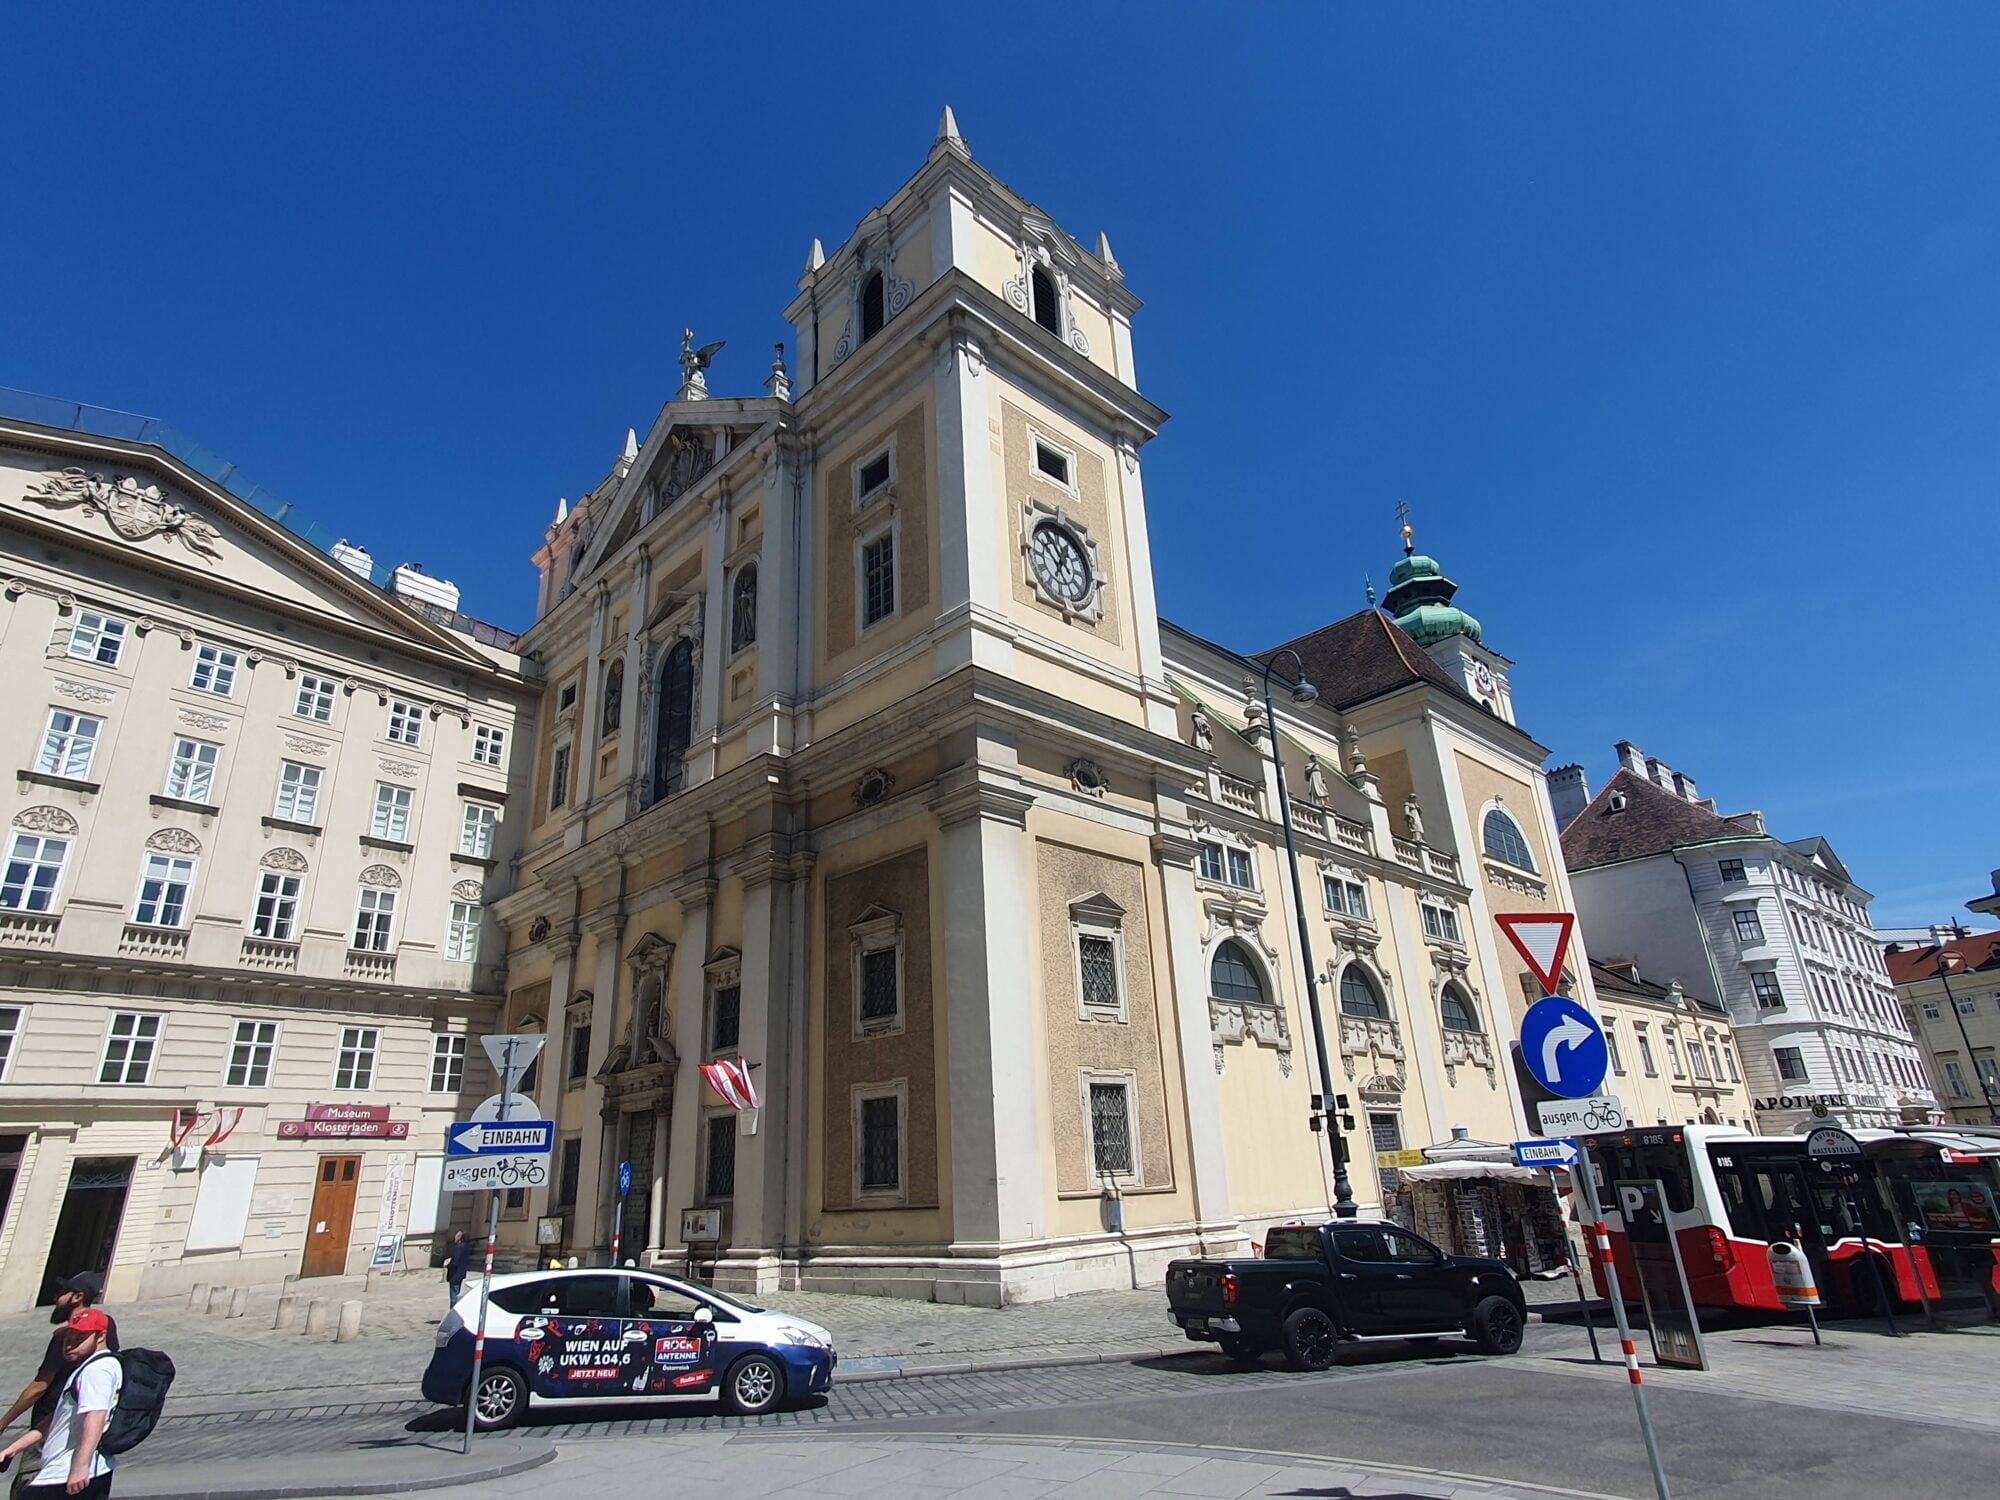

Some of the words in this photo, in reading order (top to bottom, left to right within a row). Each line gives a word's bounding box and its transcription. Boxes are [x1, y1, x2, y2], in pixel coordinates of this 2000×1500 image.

[1754, 1094, 1848, 1110] APOTHEKE
[327, 1107, 371, 1119] Museum
[1541, 1111, 1583, 1126] ausgen.
[313, 1121, 379, 1132] Klosterladen
[482, 1130, 542, 1145] EINBAHN
[1643, 1134, 1664, 1145] 8185
[1814, 1131, 1846, 1142] AUTOBUS
[1524, 1147, 1561, 1159] EINBAHN
[1812, 1146, 1856, 1154] HALTESTELLE
[1716, 1156, 1734, 1167] 8185
[1620, 1187, 1644, 1222] P
[565, 1341, 600, 1352] WIEN
[601, 1340, 629, 1352] AUF
[662, 1340, 694, 1350] ROCK
[560, 1354, 592, 1366] UKW
[593, 1353, 631, 1367] 104,6
[657, 1352, 697, 1360] ANTENNE
[571, 1369, 595, 1378] JETZT
[596, 1368, 617, 1378] NEU!
